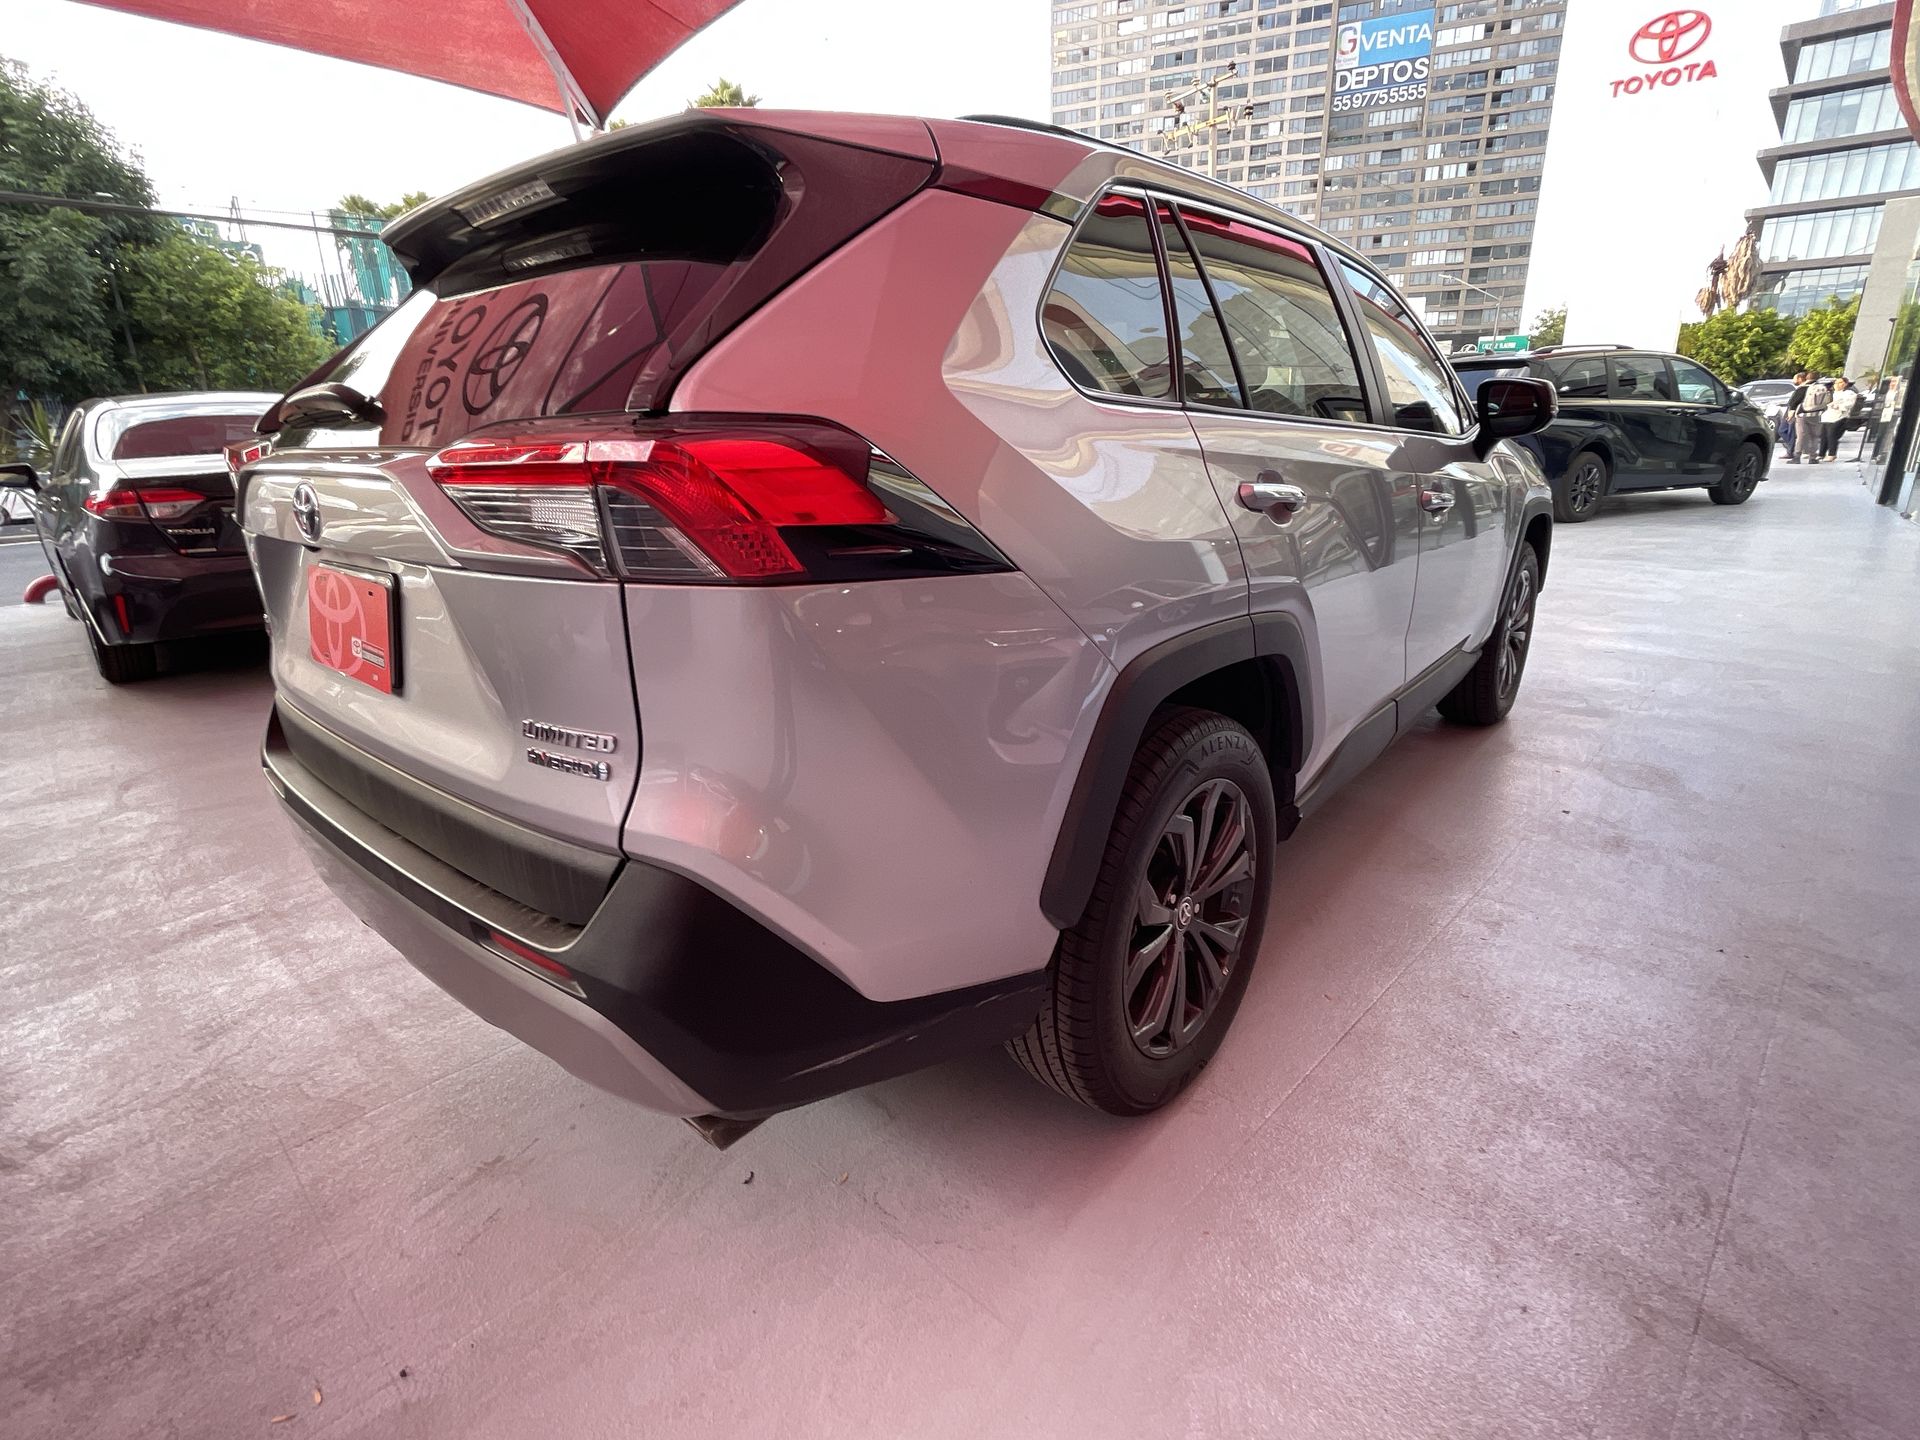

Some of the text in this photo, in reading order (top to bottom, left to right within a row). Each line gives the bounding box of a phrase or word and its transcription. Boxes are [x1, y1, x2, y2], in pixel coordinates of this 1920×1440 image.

[1358, 23, 1433, 51] VENTA
[1335, 57, 1430, 92] DEPTOS
[1609, 60, 1718, 98] TOYOTA
[521, 718, 618, 755] LIMITED
[1201, 735, 1250, 761] ALENZA
